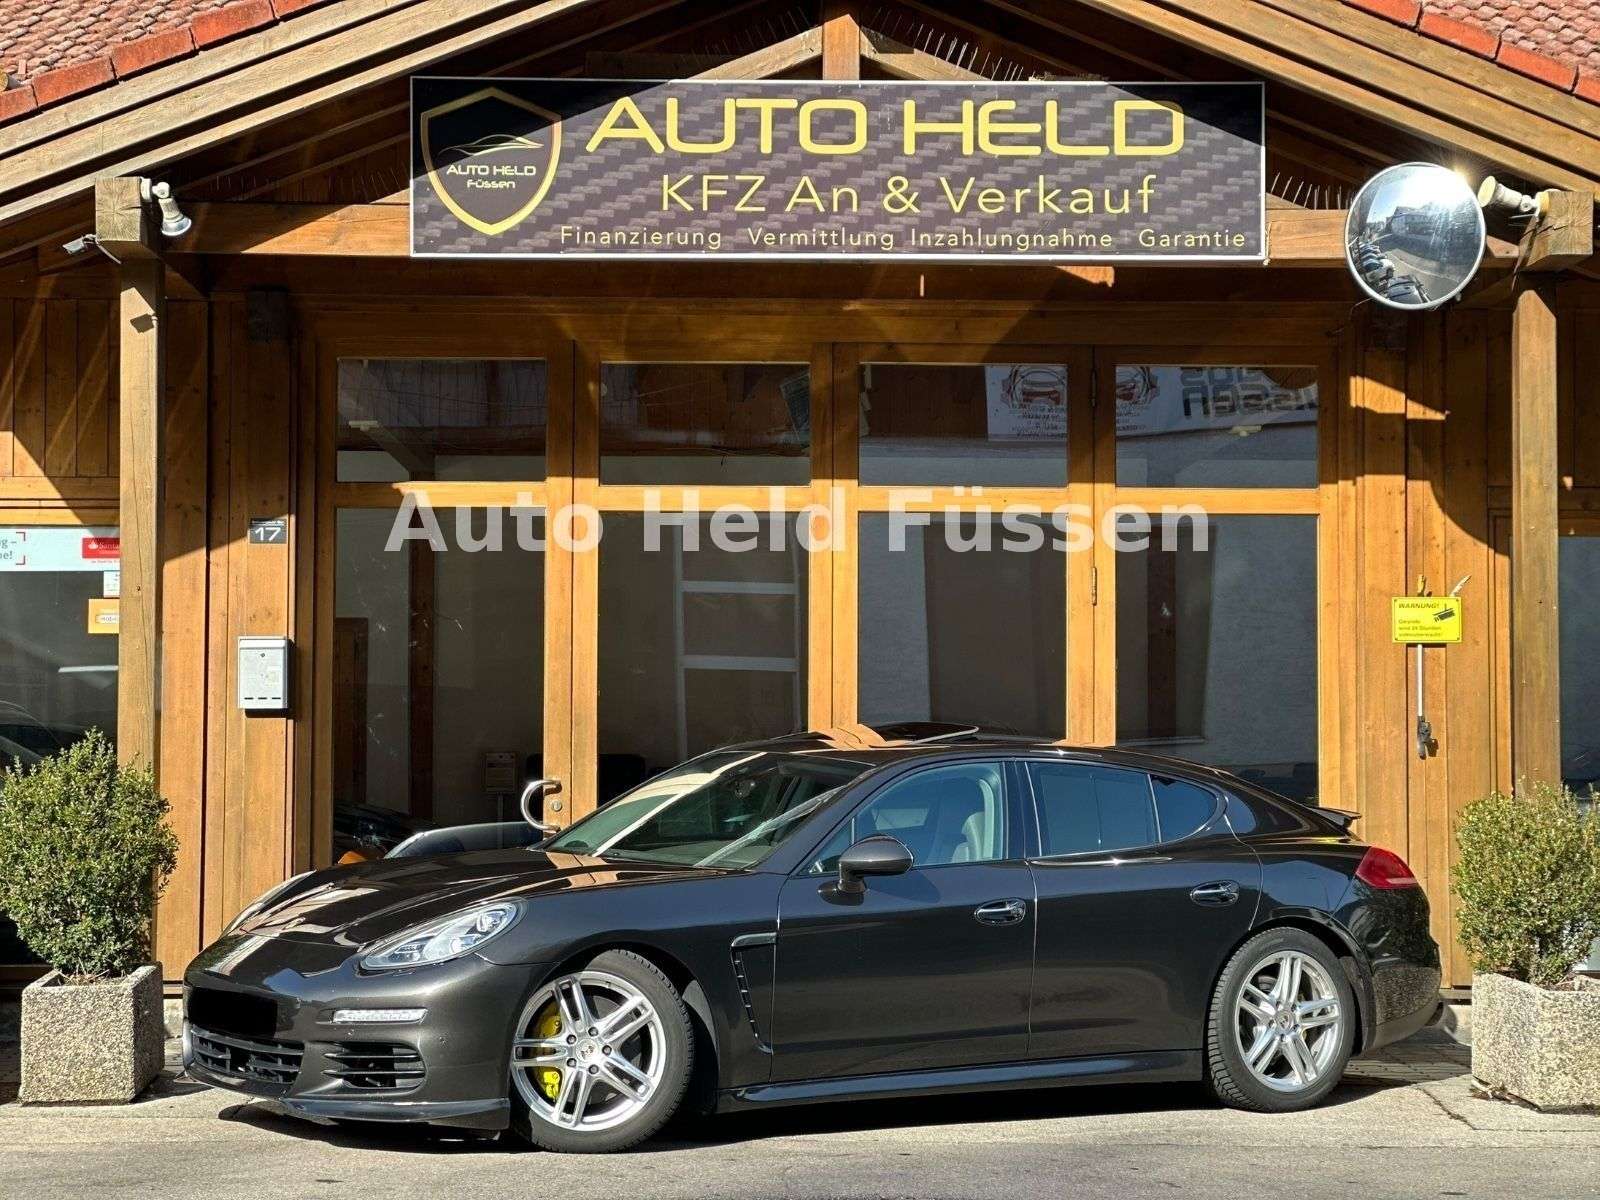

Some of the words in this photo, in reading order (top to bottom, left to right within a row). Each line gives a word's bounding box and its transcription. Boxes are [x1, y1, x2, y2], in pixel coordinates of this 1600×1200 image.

[585, 97, 867, 155] AUTO
[904, 99, 1184, 156] HELD
[446, 164, 489, 176] AUTO
[493, 165, 537, 177] HELD
[466, 179, 517, 189] Füssen
[662, 174, 766, 213] KFZ
[785, 175, 859, 213] An
[883, 175, 920, 214] &
[940, 174, 1157, 214] Verkauf
[561, 226, 722, 250] Finanzierung
[748, 227, 895, 250] Vermittlung
[911, 228, 1113, 250] Inzahlungnahme
[1139, 228, 1246, 248] Garantie
[254, 526, 282, 541] 17
